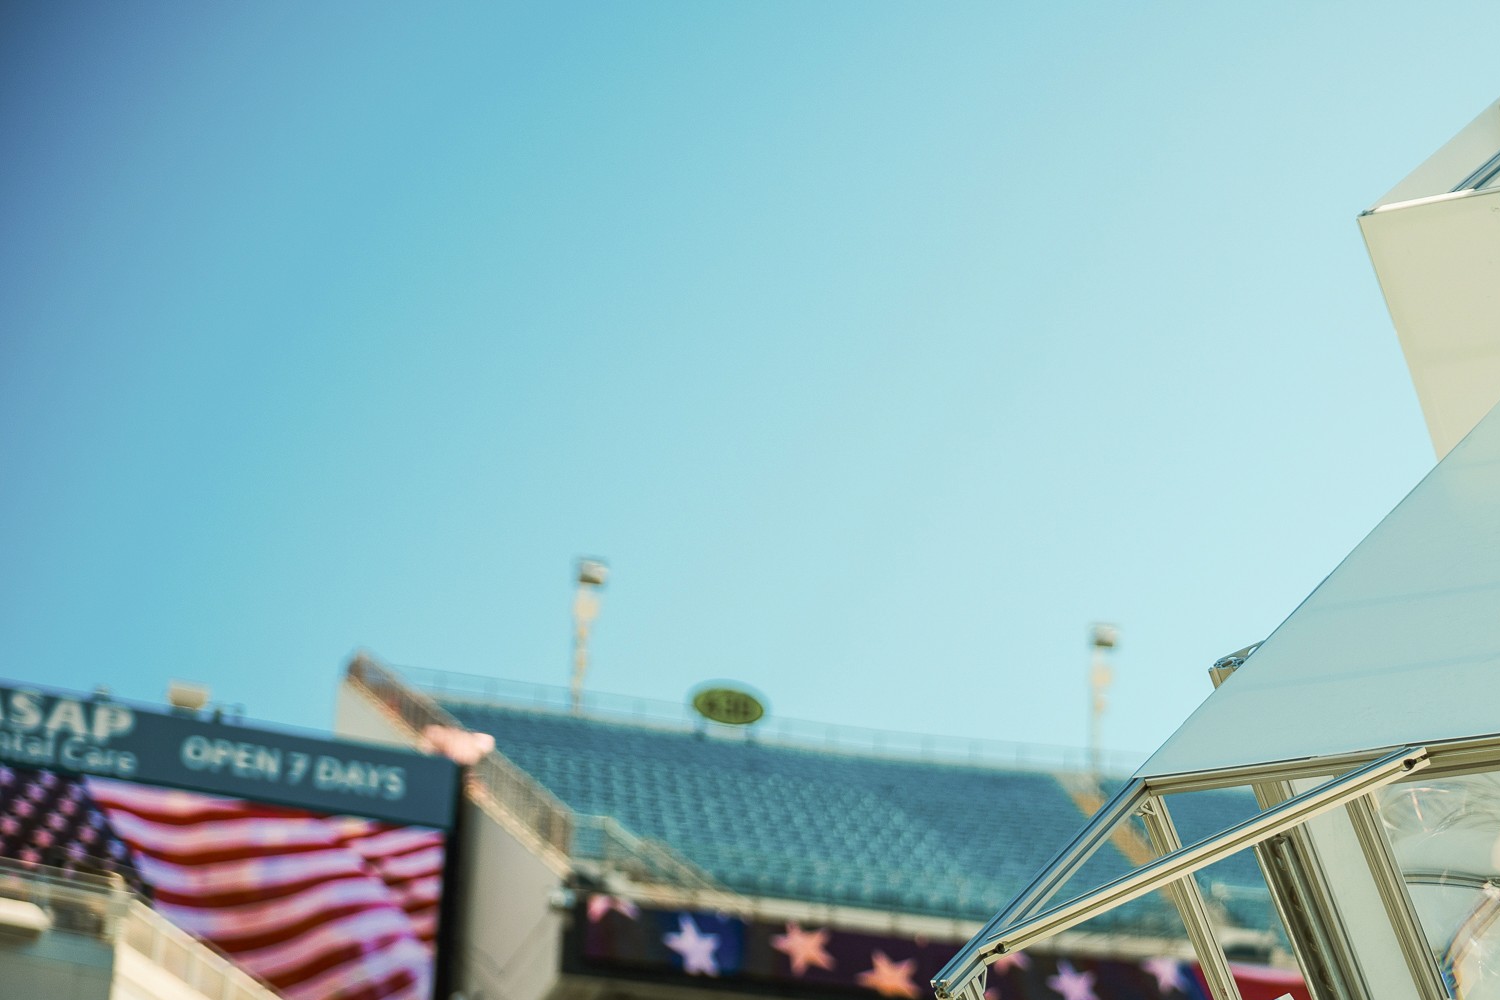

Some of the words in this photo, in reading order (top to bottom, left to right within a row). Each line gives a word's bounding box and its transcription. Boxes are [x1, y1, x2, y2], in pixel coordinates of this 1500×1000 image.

[0, 691, 136, 741] SAP
[180, 736, 282, 782] OPEN
[286, 751, 311, 786] 7
[313, 755, 406, 801] DAYS
